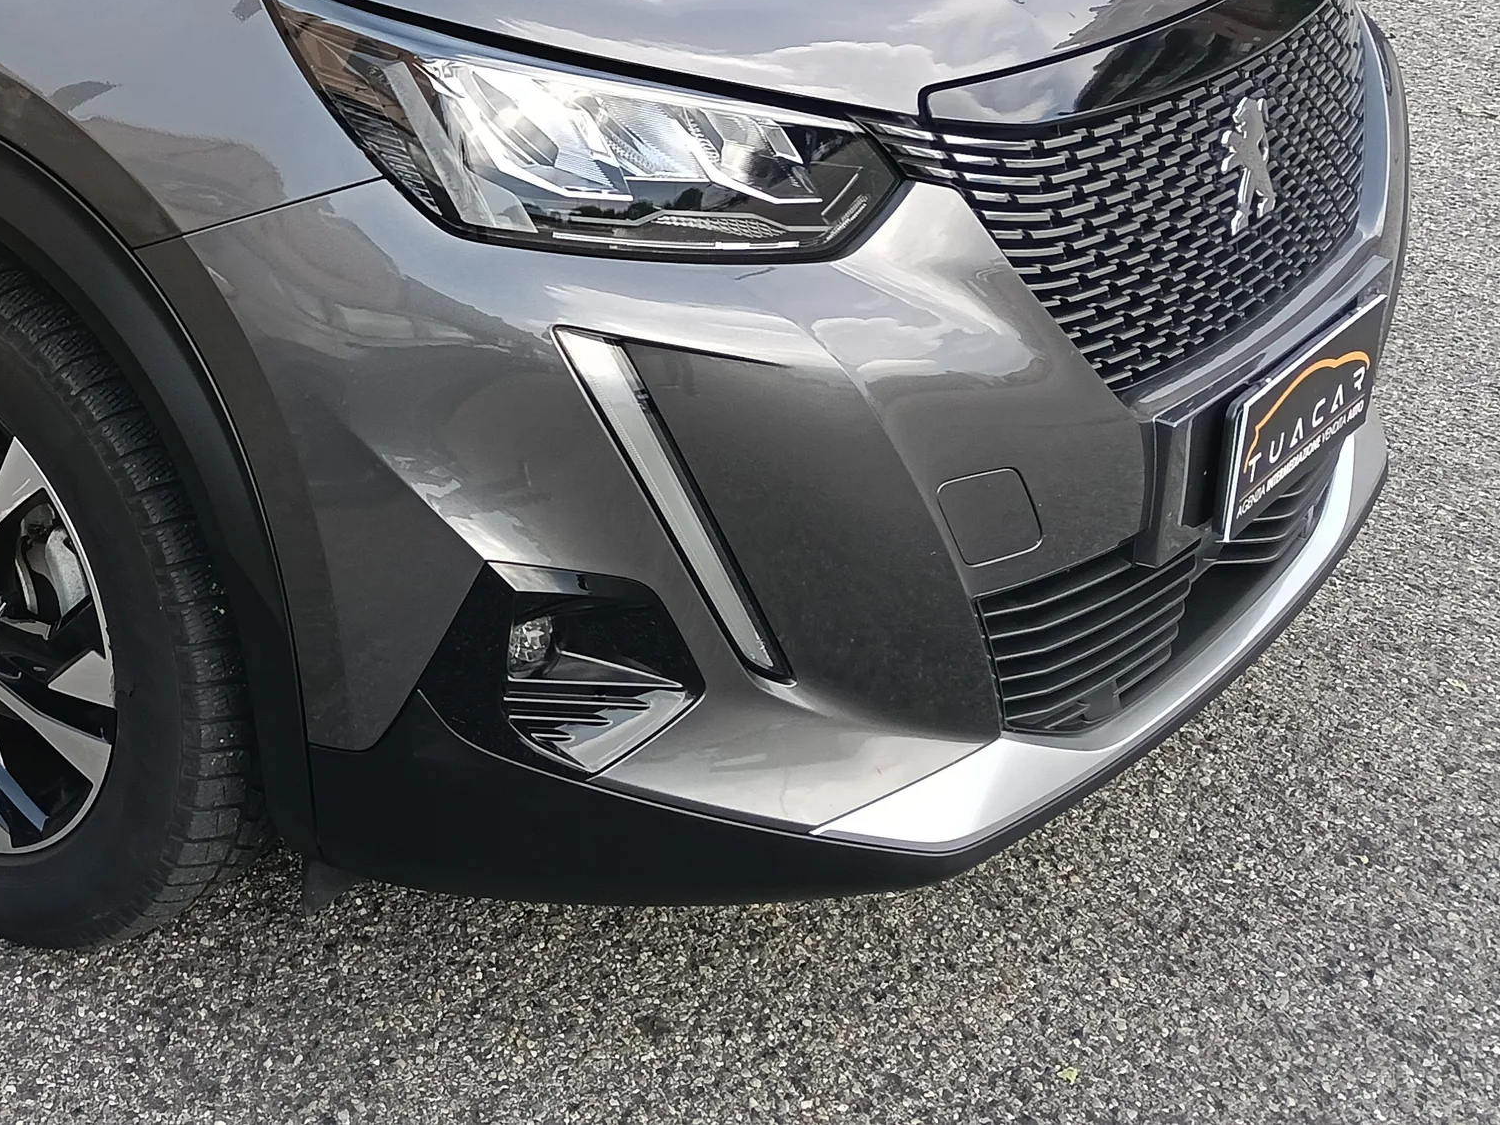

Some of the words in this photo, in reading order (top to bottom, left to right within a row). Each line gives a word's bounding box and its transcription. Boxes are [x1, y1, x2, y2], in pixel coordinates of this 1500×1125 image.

[1236, 484, 1266, 520] AGENZIA
[1321, 415, 1348, 444] VENDITA
[1346, 399, 1365, 424] AUTO
